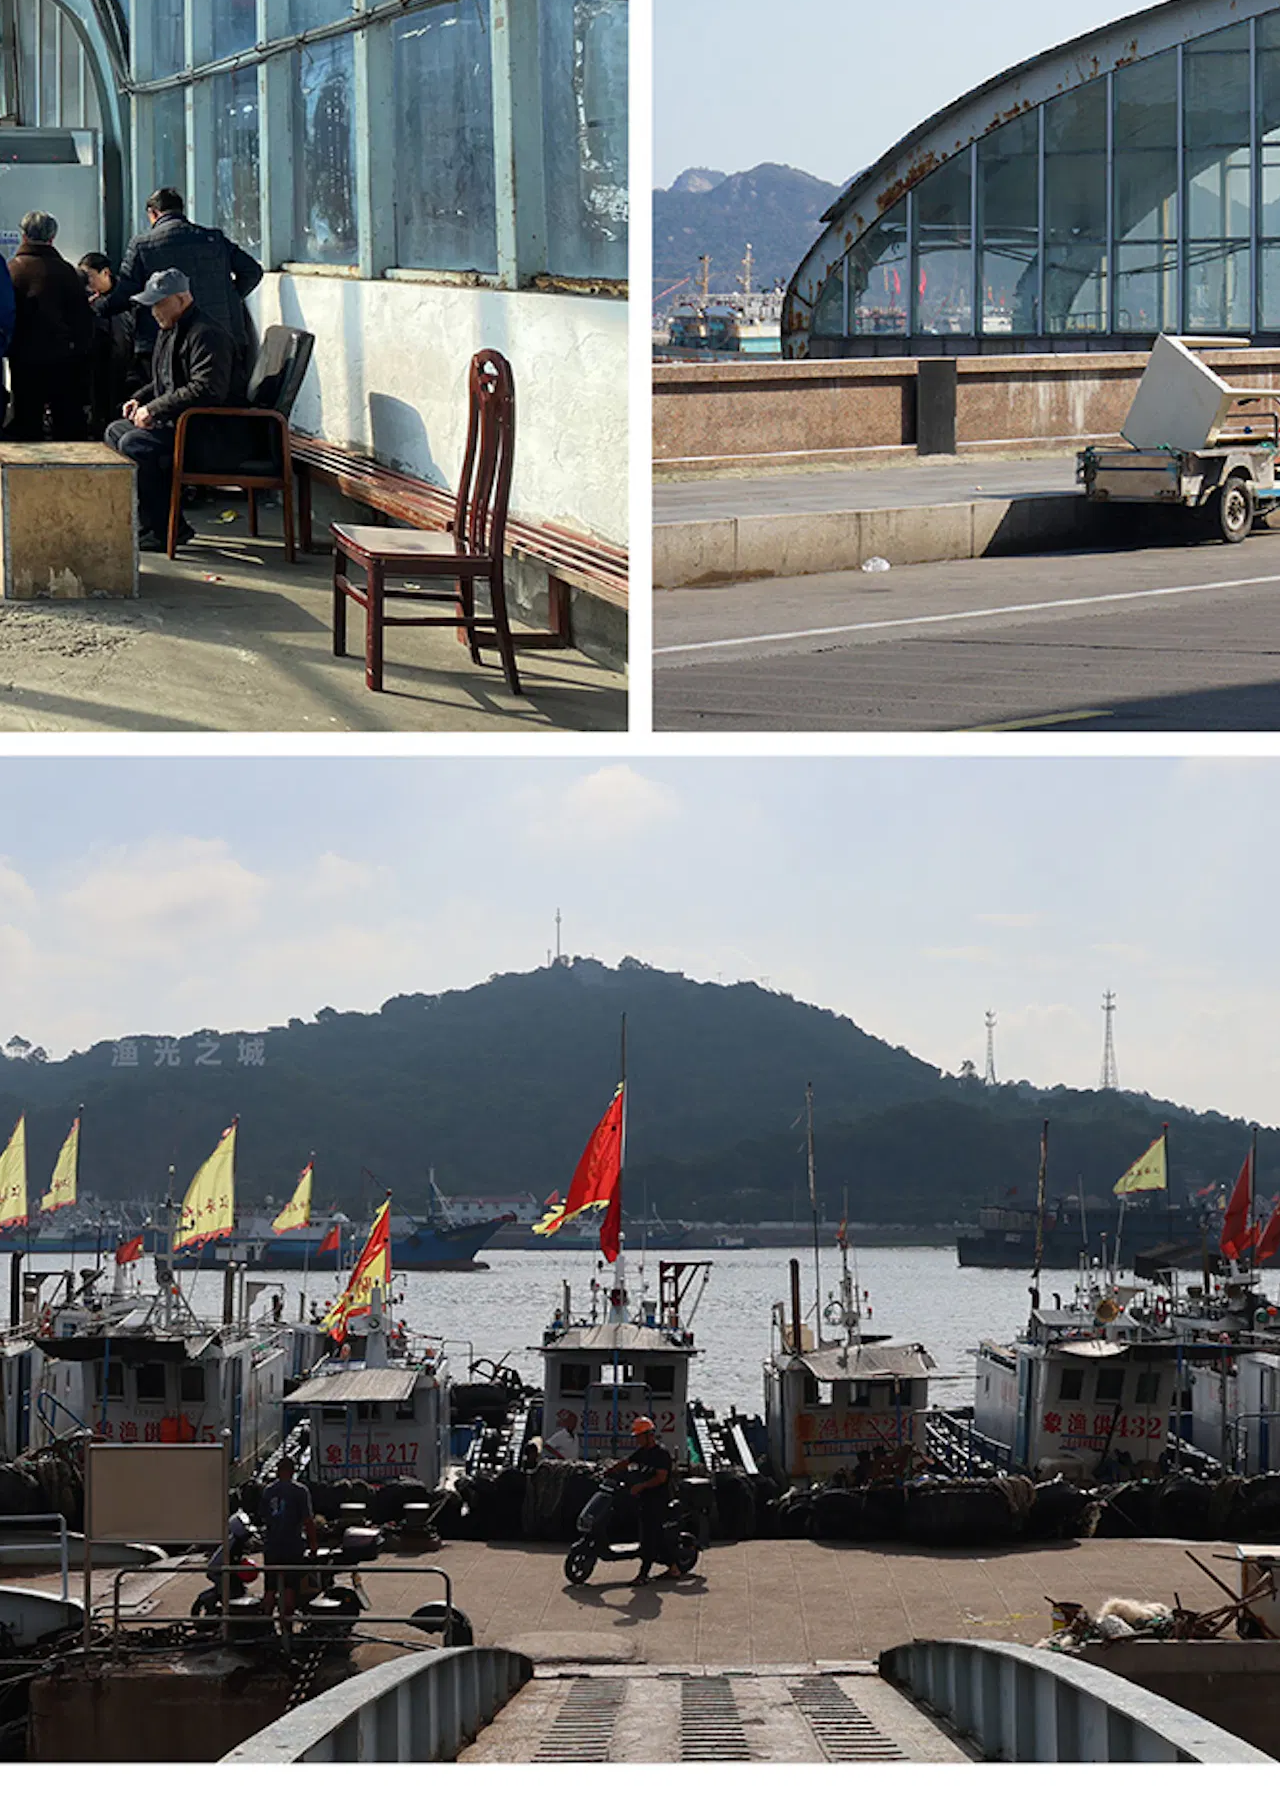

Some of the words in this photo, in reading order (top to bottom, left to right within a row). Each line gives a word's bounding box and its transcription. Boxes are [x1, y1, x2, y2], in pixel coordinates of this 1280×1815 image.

[111, 1038, 267, 1067] 渔光之城
[1042, 1411, 1162, 1440] 象渔供432
[326, 1443, 419, 1465] 象渔供217
